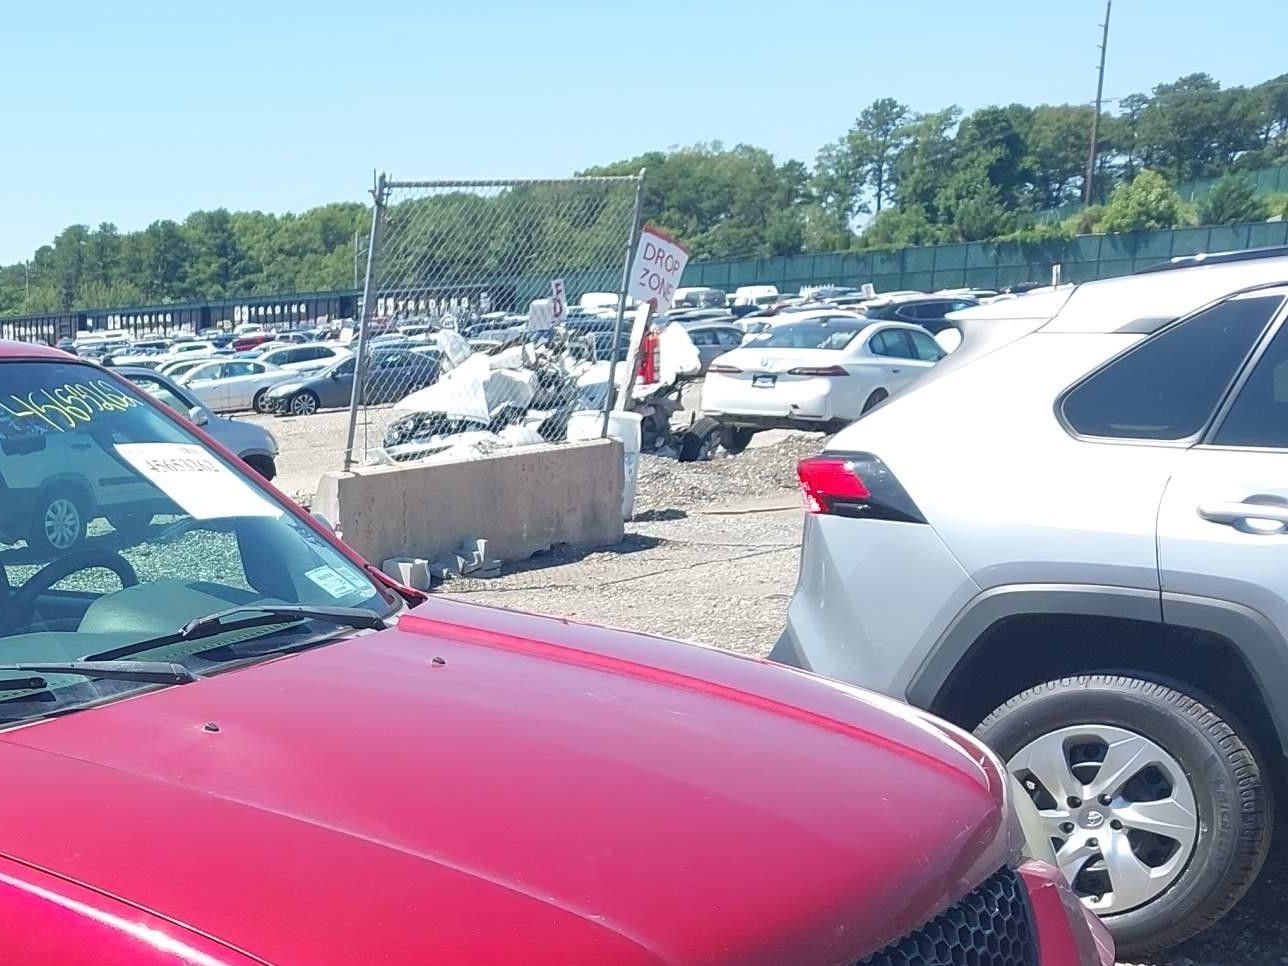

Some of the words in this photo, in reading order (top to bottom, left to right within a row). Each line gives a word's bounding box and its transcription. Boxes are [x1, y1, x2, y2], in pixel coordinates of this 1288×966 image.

[643, 242, 680, 276] DROP
[639, 268, 674, 302] ZONE
[250, 303, 306, 316] TRADING
[398, 297, 469, 311] TRADING
[122, 313, 172, 325] TRADING
[15, 324, 54, 337] TRADING
[146, 459, 220, 473] 45653262
